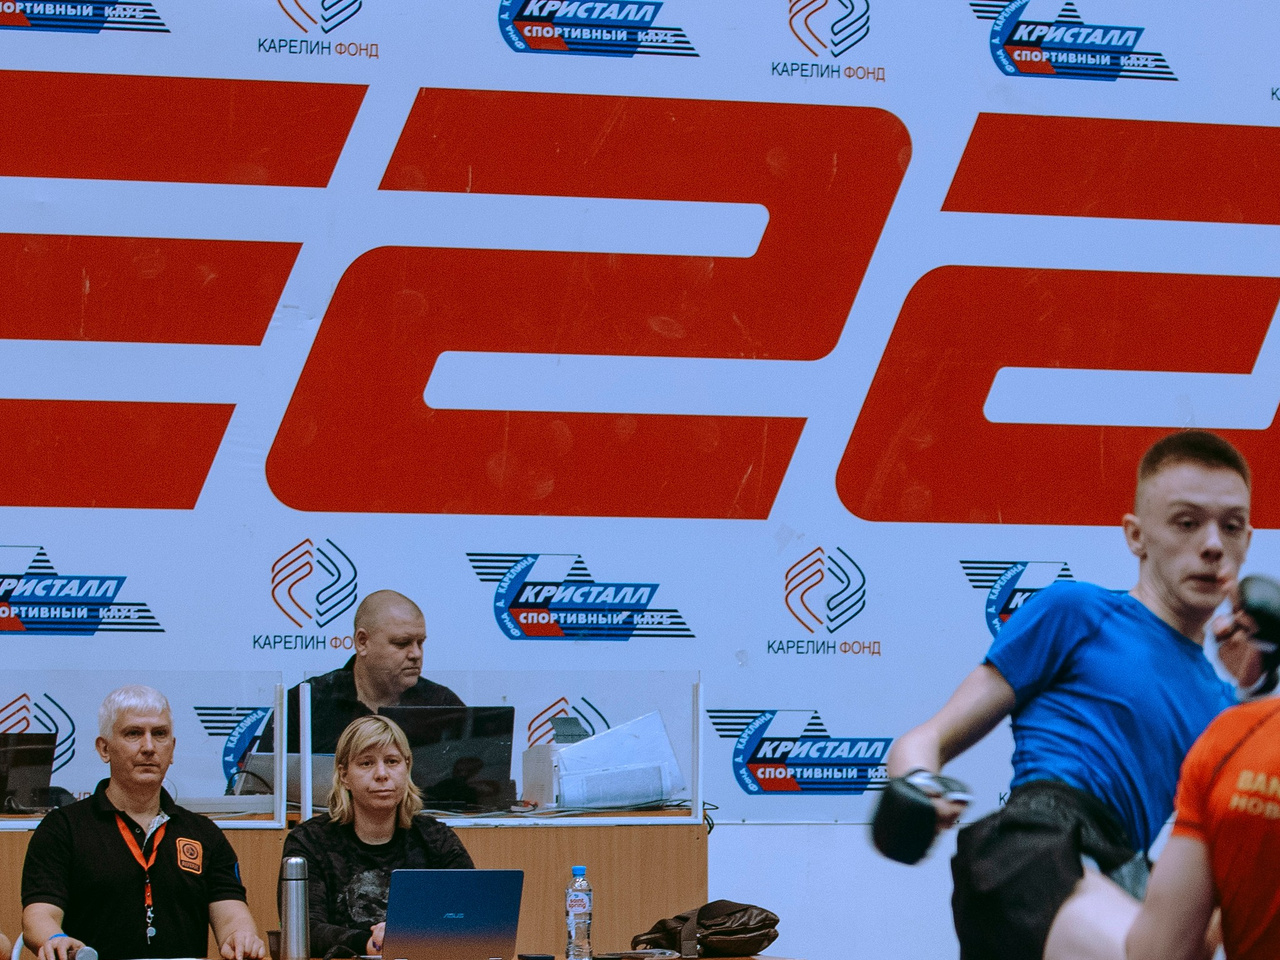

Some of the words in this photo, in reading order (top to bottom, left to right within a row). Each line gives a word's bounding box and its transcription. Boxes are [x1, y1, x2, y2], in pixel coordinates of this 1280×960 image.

[0, 2, 93, 16] ОРТИВНЫЙ
[523, 0, 654, 21] КРИСТАЛЛ
[523, 26, 627, 42] СПОРТИВНЫЙ
[1012, 24, 1137, 47] КРИСТАЛЛ
[258, 38, 331, 55] КАРЕЛИН
[335, 42, 380, 59] ФОНД
[1013, 50, 1111, 66] СПОРТИВНЫЙ
[771, 62, 841, 79] КАРЕЛИН
[844, 66, 886, 82] ФОНД
[497, 556, 536, 594] КАРЕЛИНА
[519, 585, 651, 604] КРИСТАЛЛ
[518, 611, 625, 625] СПОРТИВНЫЙ
[252, 635, 327, 650] КАРЕЛИН
[767, 640, 837, 655] КАРЕЛИН
[839, 640, 882, 656] ФОНД
[736, 712, 774, 750] КАРЕЛИНА
[757, 741, 883, 758] КРИСТАЛЛ
[757, 765, 858, 779] СПОРТИВНЫЙ
